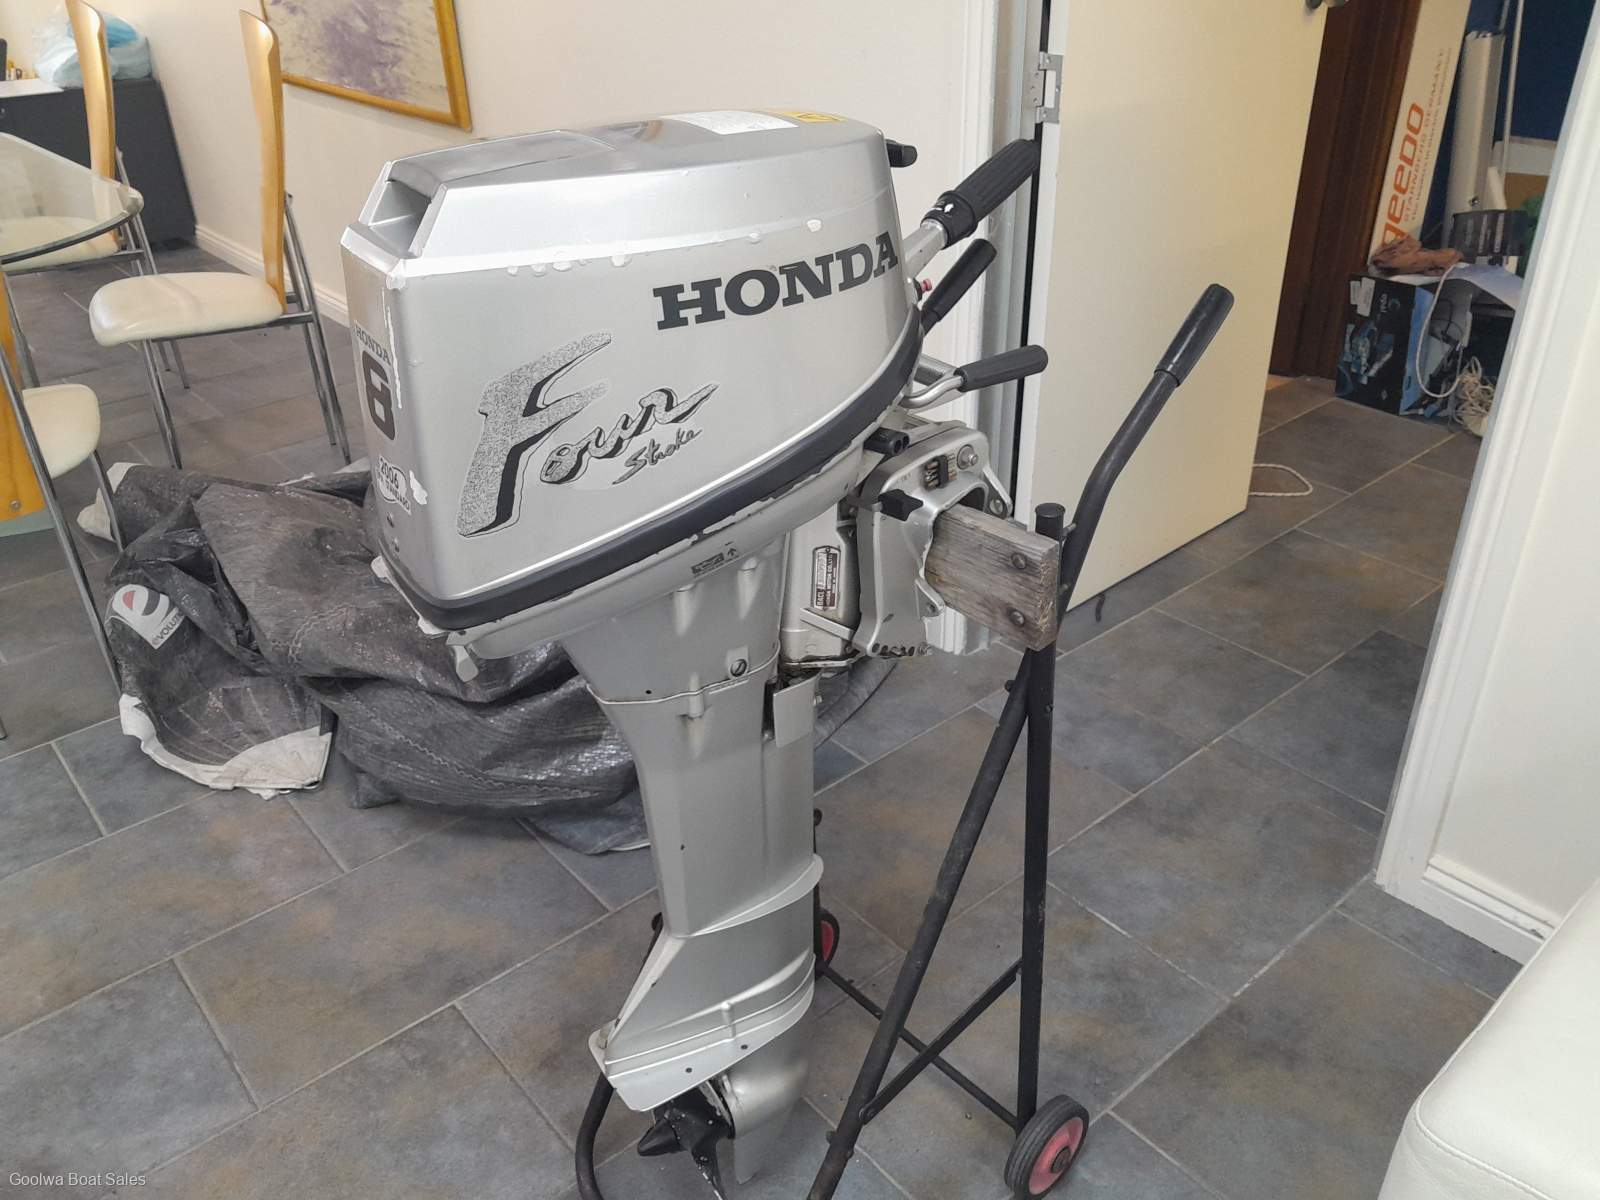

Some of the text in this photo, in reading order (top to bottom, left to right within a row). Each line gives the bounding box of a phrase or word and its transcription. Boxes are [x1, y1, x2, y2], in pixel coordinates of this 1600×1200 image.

[653, 231, 899, 330] HONDA
[355, 325, 391, 365] HONDA
[362, 350, 395, 440] 6
[457, 332, 718, 538] Four
[612, 426, 702, 485] Stroke
